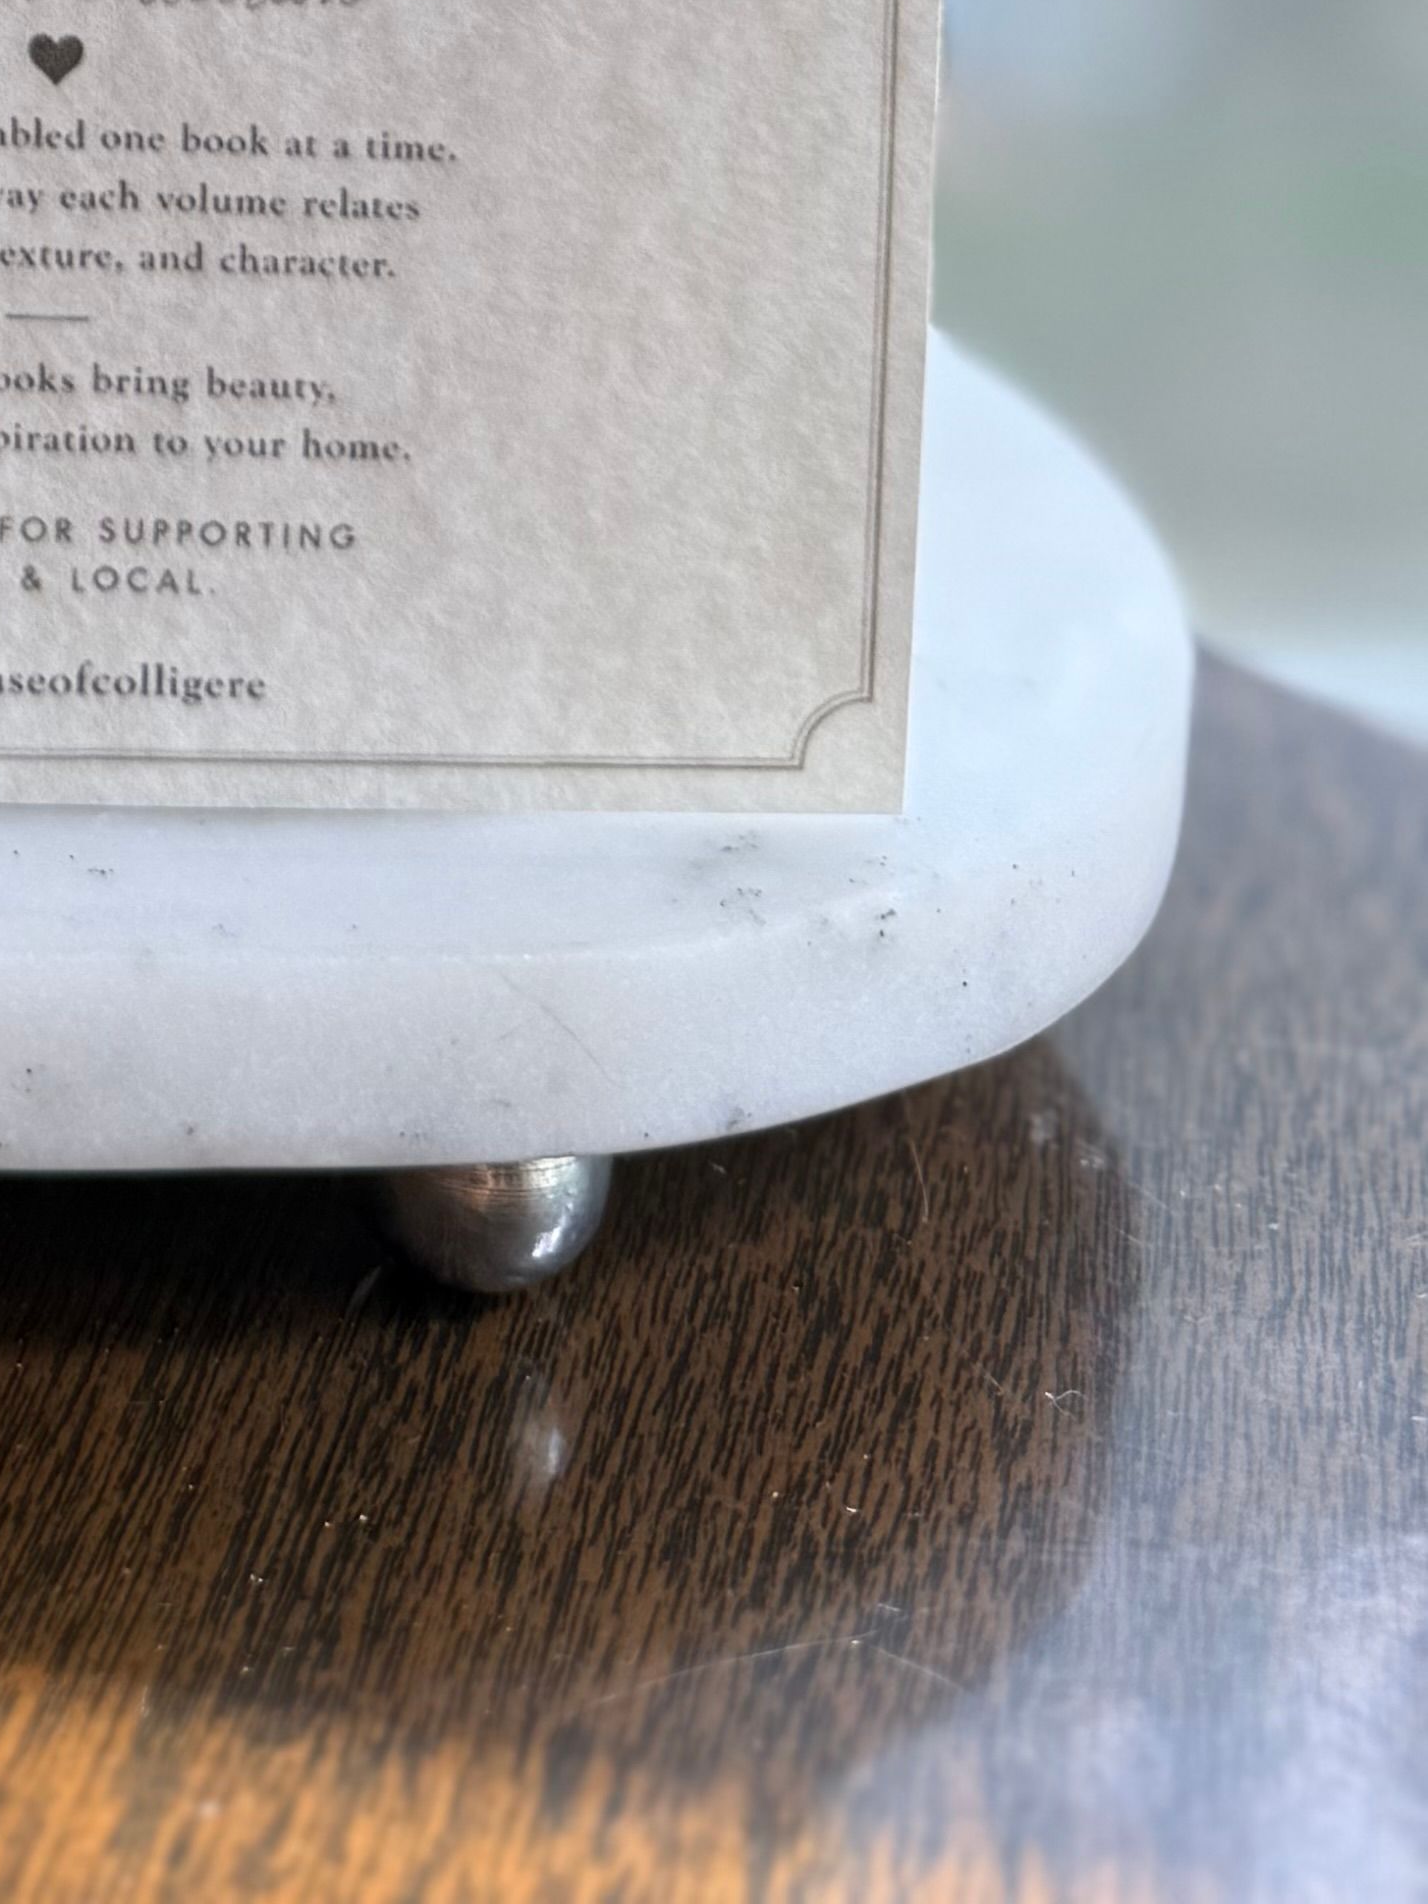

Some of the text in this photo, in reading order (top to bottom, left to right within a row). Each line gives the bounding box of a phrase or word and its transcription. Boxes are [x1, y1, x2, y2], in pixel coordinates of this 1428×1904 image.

[100, 130, 165, 153] one
[182, 123, 268, 156] book
[285, 135, 317, 158] at
[333, 138, 350, 160] a
[366, 132, 458, 162] time.
[59, 180, 141, 213] each
[156, 183, 287, 216] volume
[302, 188, 420, 221] relates
[138, 242, 204, 275] and
[220, 243, 395, 278] character.
[93, 363, 190, 402] bring
[207, 366, 336, 405] beauty,
[153, 432, 189, 456] to
[204, 434, 287, 462] your
[302, 428, 411, 463] home.
[99, 517, 355, 550] SUPPORTING
[20, 565, 42, 593] &
